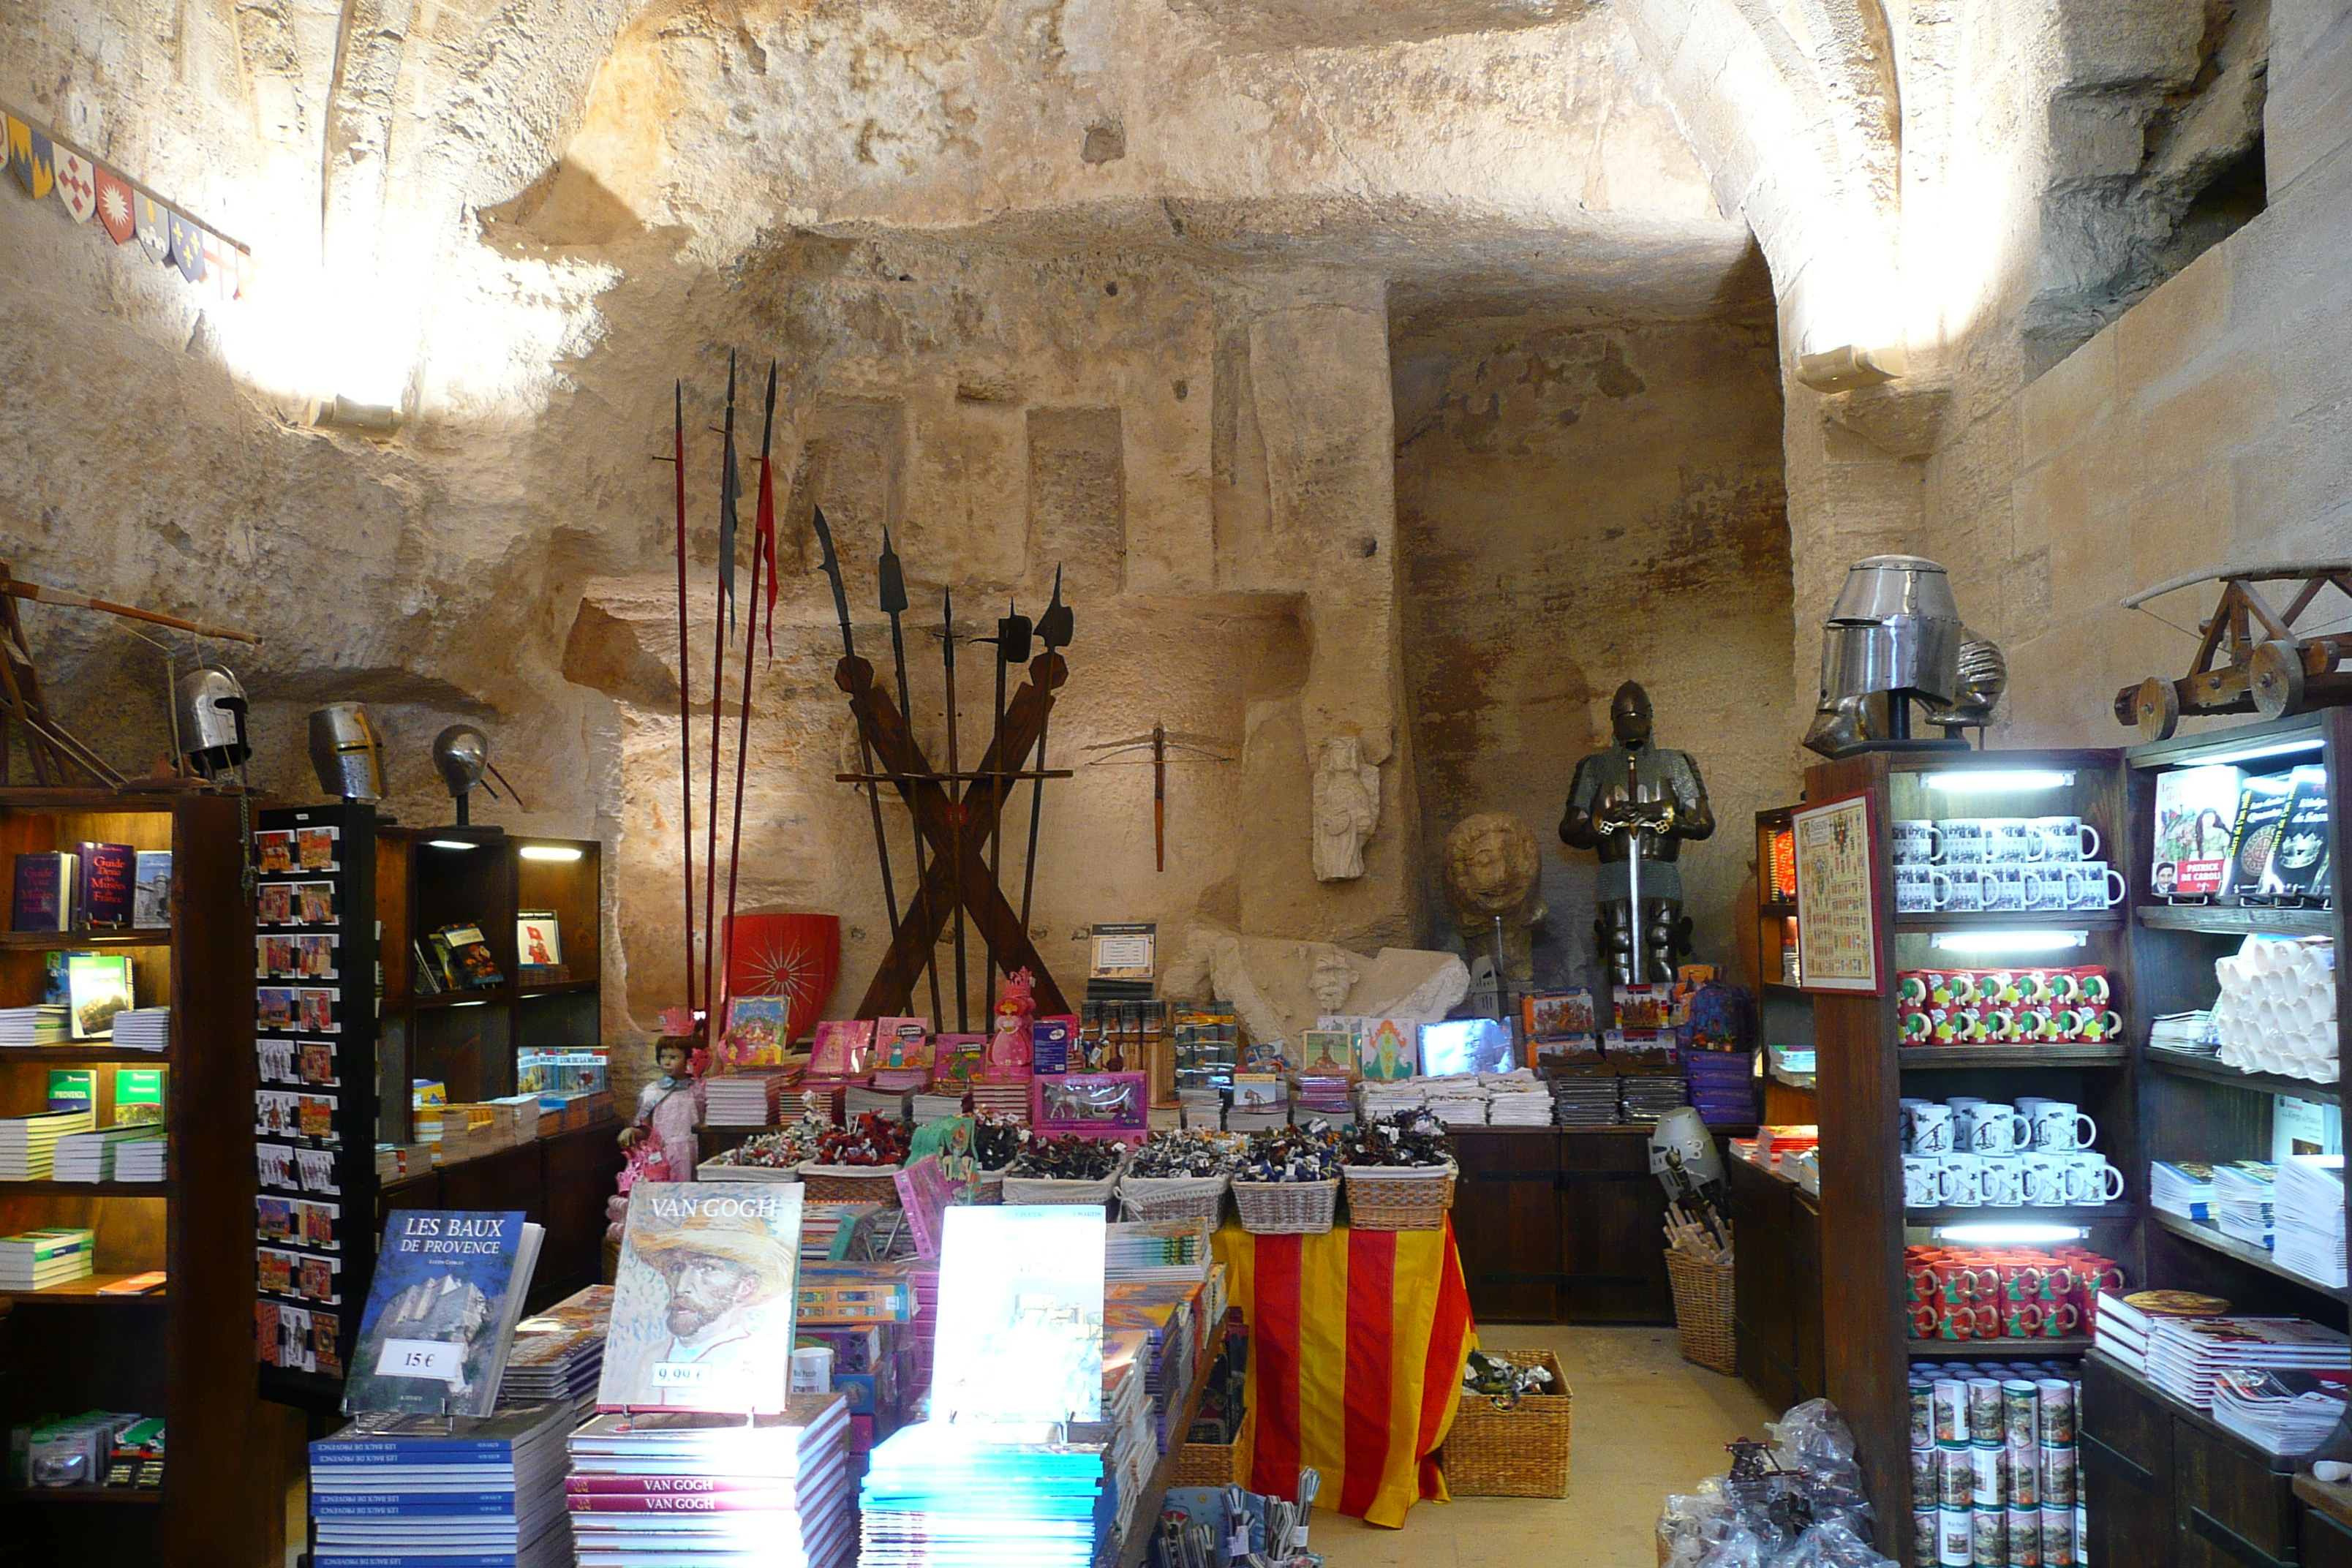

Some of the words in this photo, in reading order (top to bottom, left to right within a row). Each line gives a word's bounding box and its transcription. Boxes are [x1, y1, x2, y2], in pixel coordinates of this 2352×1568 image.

[93, 856, 126, 869] Guide
[2186, 863, 2219, 872] PATRICK
[2181, 873, 2192, 882] DE
[2193, 872, 2221, 881] CAROLI
[91, 877, 127, 890] Musées
[93, 891, 123, 903] France
[651, 1198, 698, 1218] VAN
[702, 1199, 777, 1218] GOGH
[404, 1218, 441, 1236] LES
[447, 1218, 505, 1237] BAUX
[400, 1239, 419, 1253] DE
[423, 1241, 501, 1255] PROVENCE
[404, 1352, 421, 1367] 15
[425, 1353, 436, 1368] €
[658, 1368, 691, 1382] 9.99
[317, 1443, 354, 1451] PROVENCE
[355, 1443, 366, 1451] DE
[366, 1443, 382, 1451] BAUX
[385, 1443, 396, 1451] LES
[644, 1480, 671, 1491] VAN
[674, 1480, 714, 1491] GOGH
[646, 1499, 674, 1509] VAN
[676, 1498, 715, 1510] GOGH
